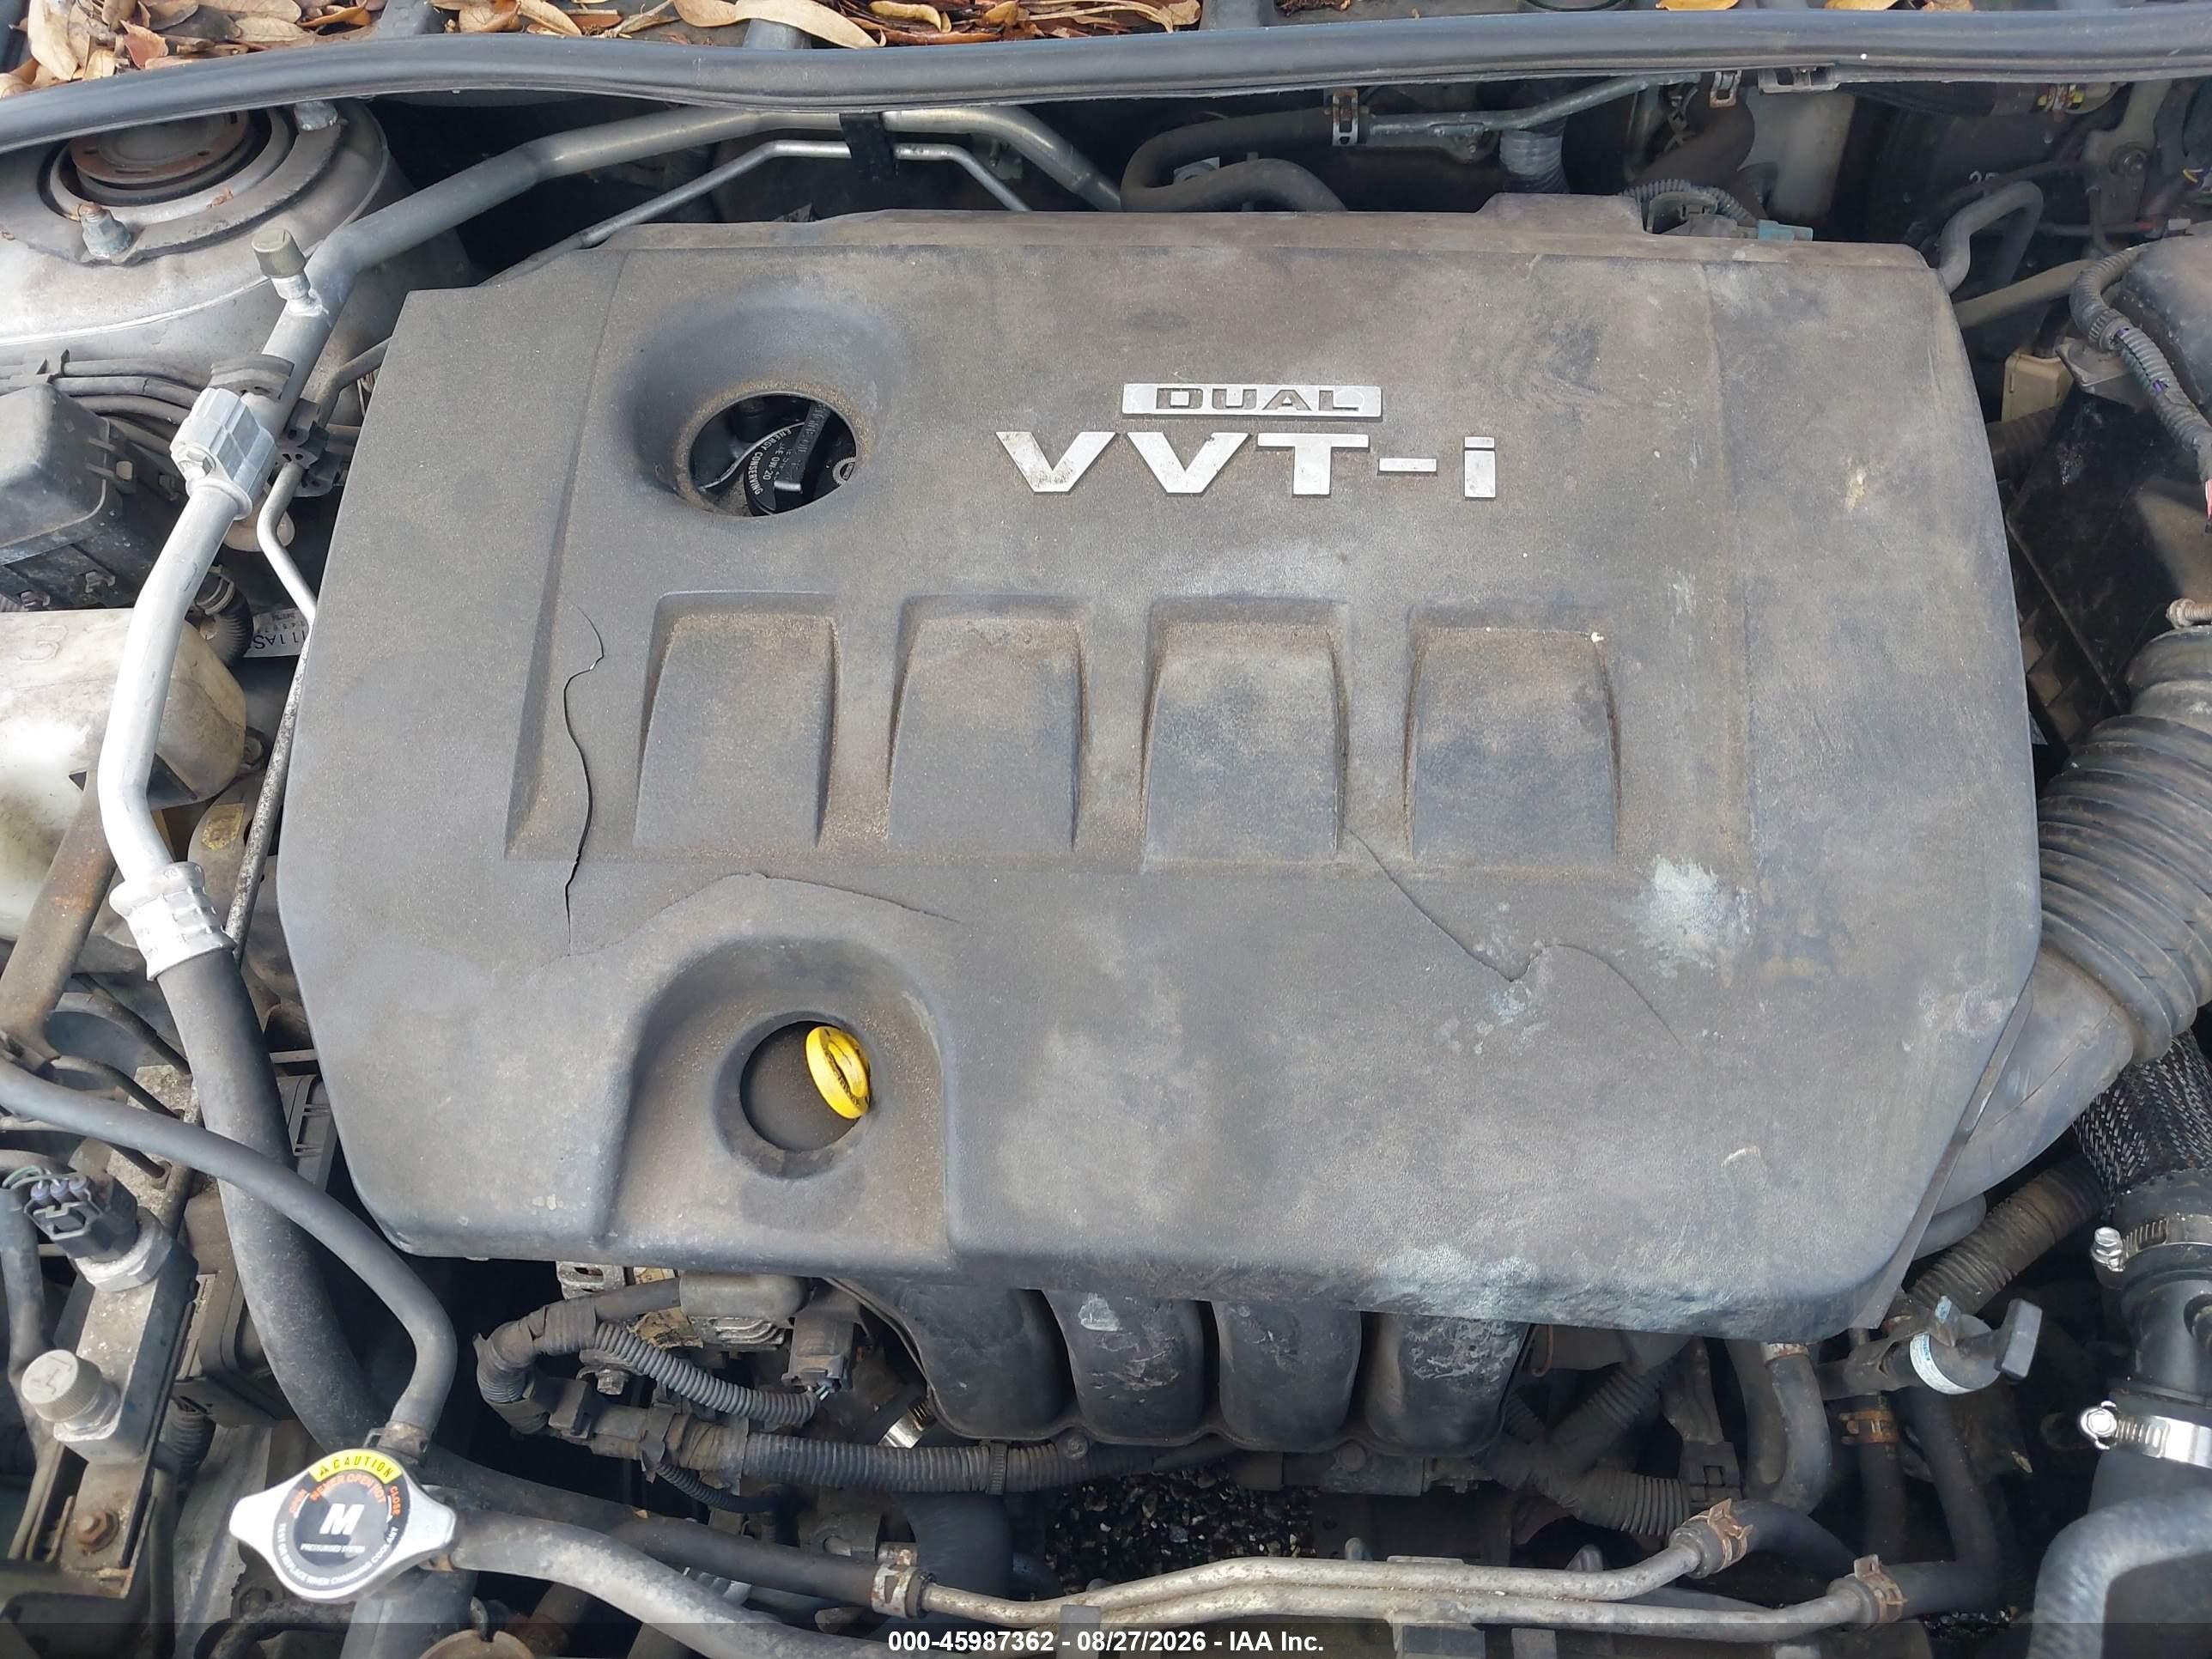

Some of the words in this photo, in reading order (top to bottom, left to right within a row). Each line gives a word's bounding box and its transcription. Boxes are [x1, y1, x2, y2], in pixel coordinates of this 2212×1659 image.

[1155, 386, 1360, 411] DUAL
[760, 428, 792, 451] ENERGY
[748, 451, 763, 495] CONSERVING
[995, 431, 1496, 499] VVT-i
[333, 1455, 394, 1478] CAUTION
[346, 1474, 374, 1488] OPEN
[389, 1486, 403, 1516] CLOSE
[319, 1503, 365, 1535] M
[370, 1526, 399, 1563] COOLANT
